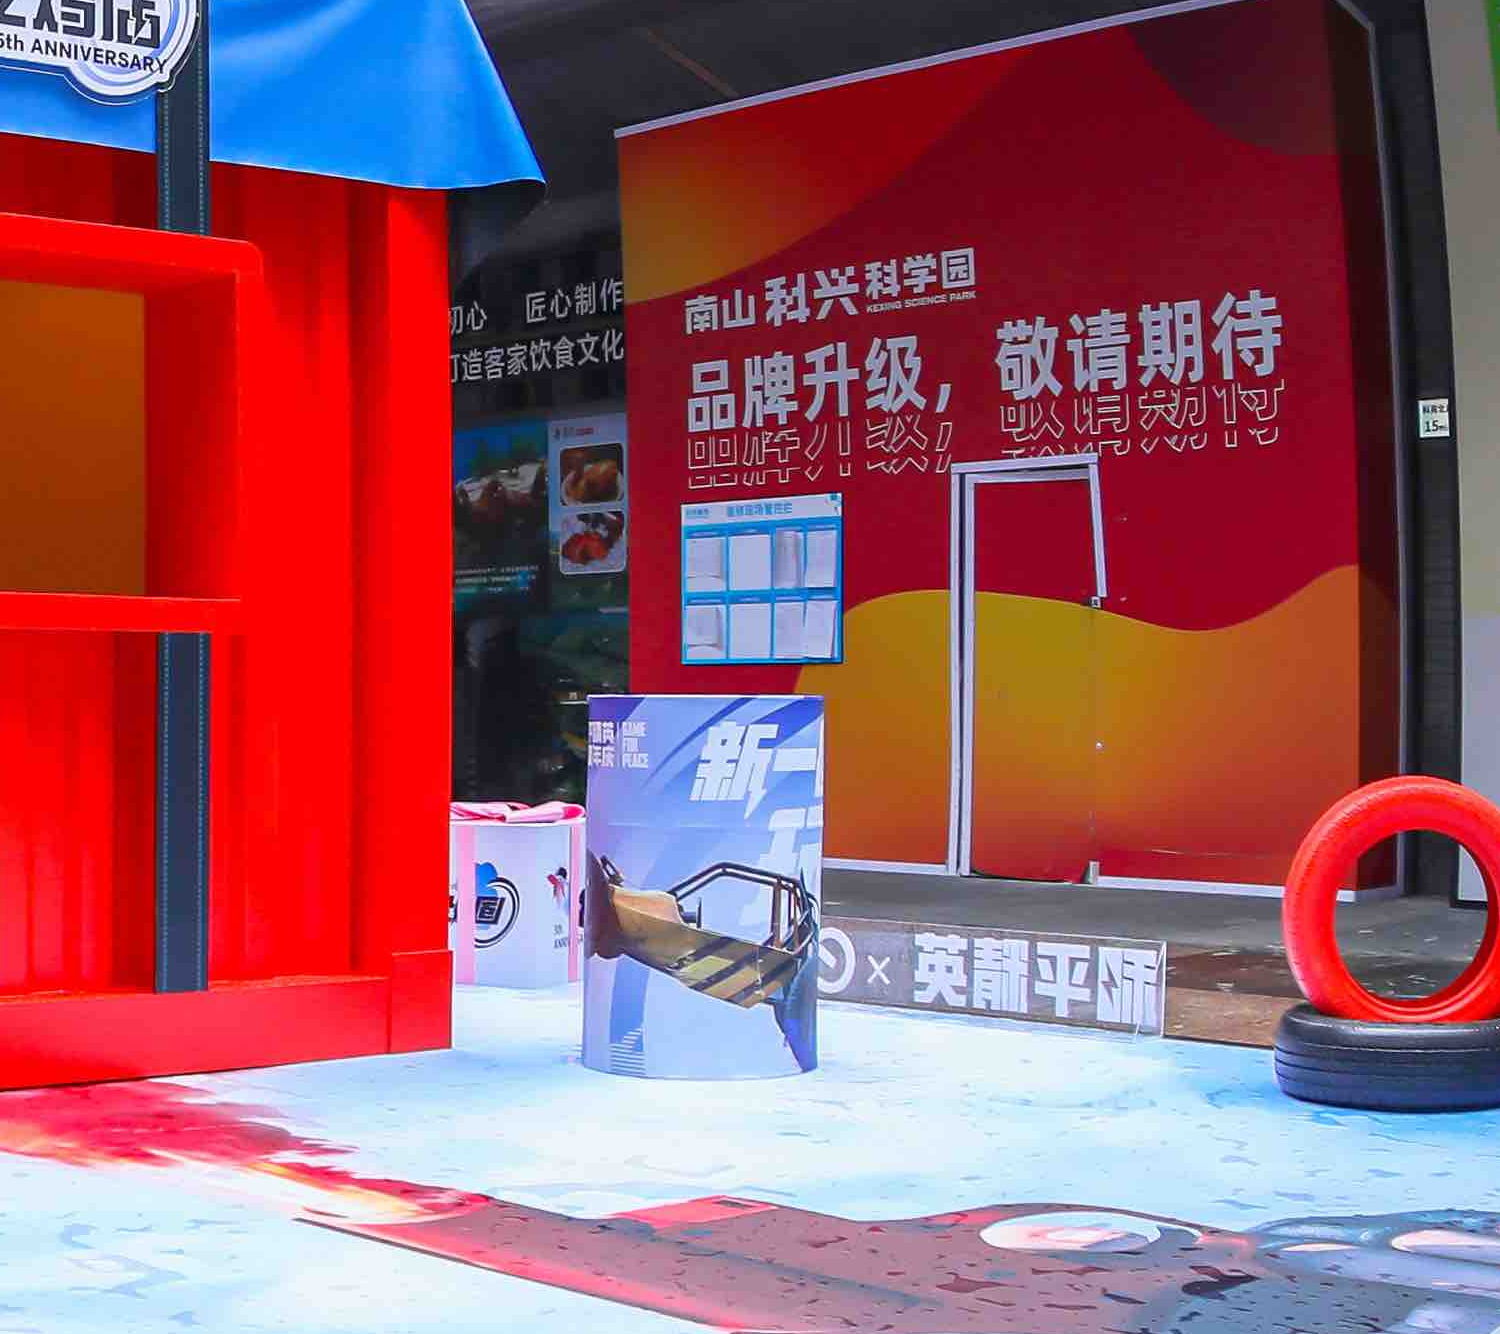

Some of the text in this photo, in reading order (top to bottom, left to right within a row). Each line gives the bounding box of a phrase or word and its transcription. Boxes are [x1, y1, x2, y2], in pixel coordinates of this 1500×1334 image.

[30, 37, 169, 77] ANNIVERSARY
[525, 277, 625, 324] 匠心制作
[903, 294, 949, 309] SCIENCE
[949, 289, 978, 303] PARK
